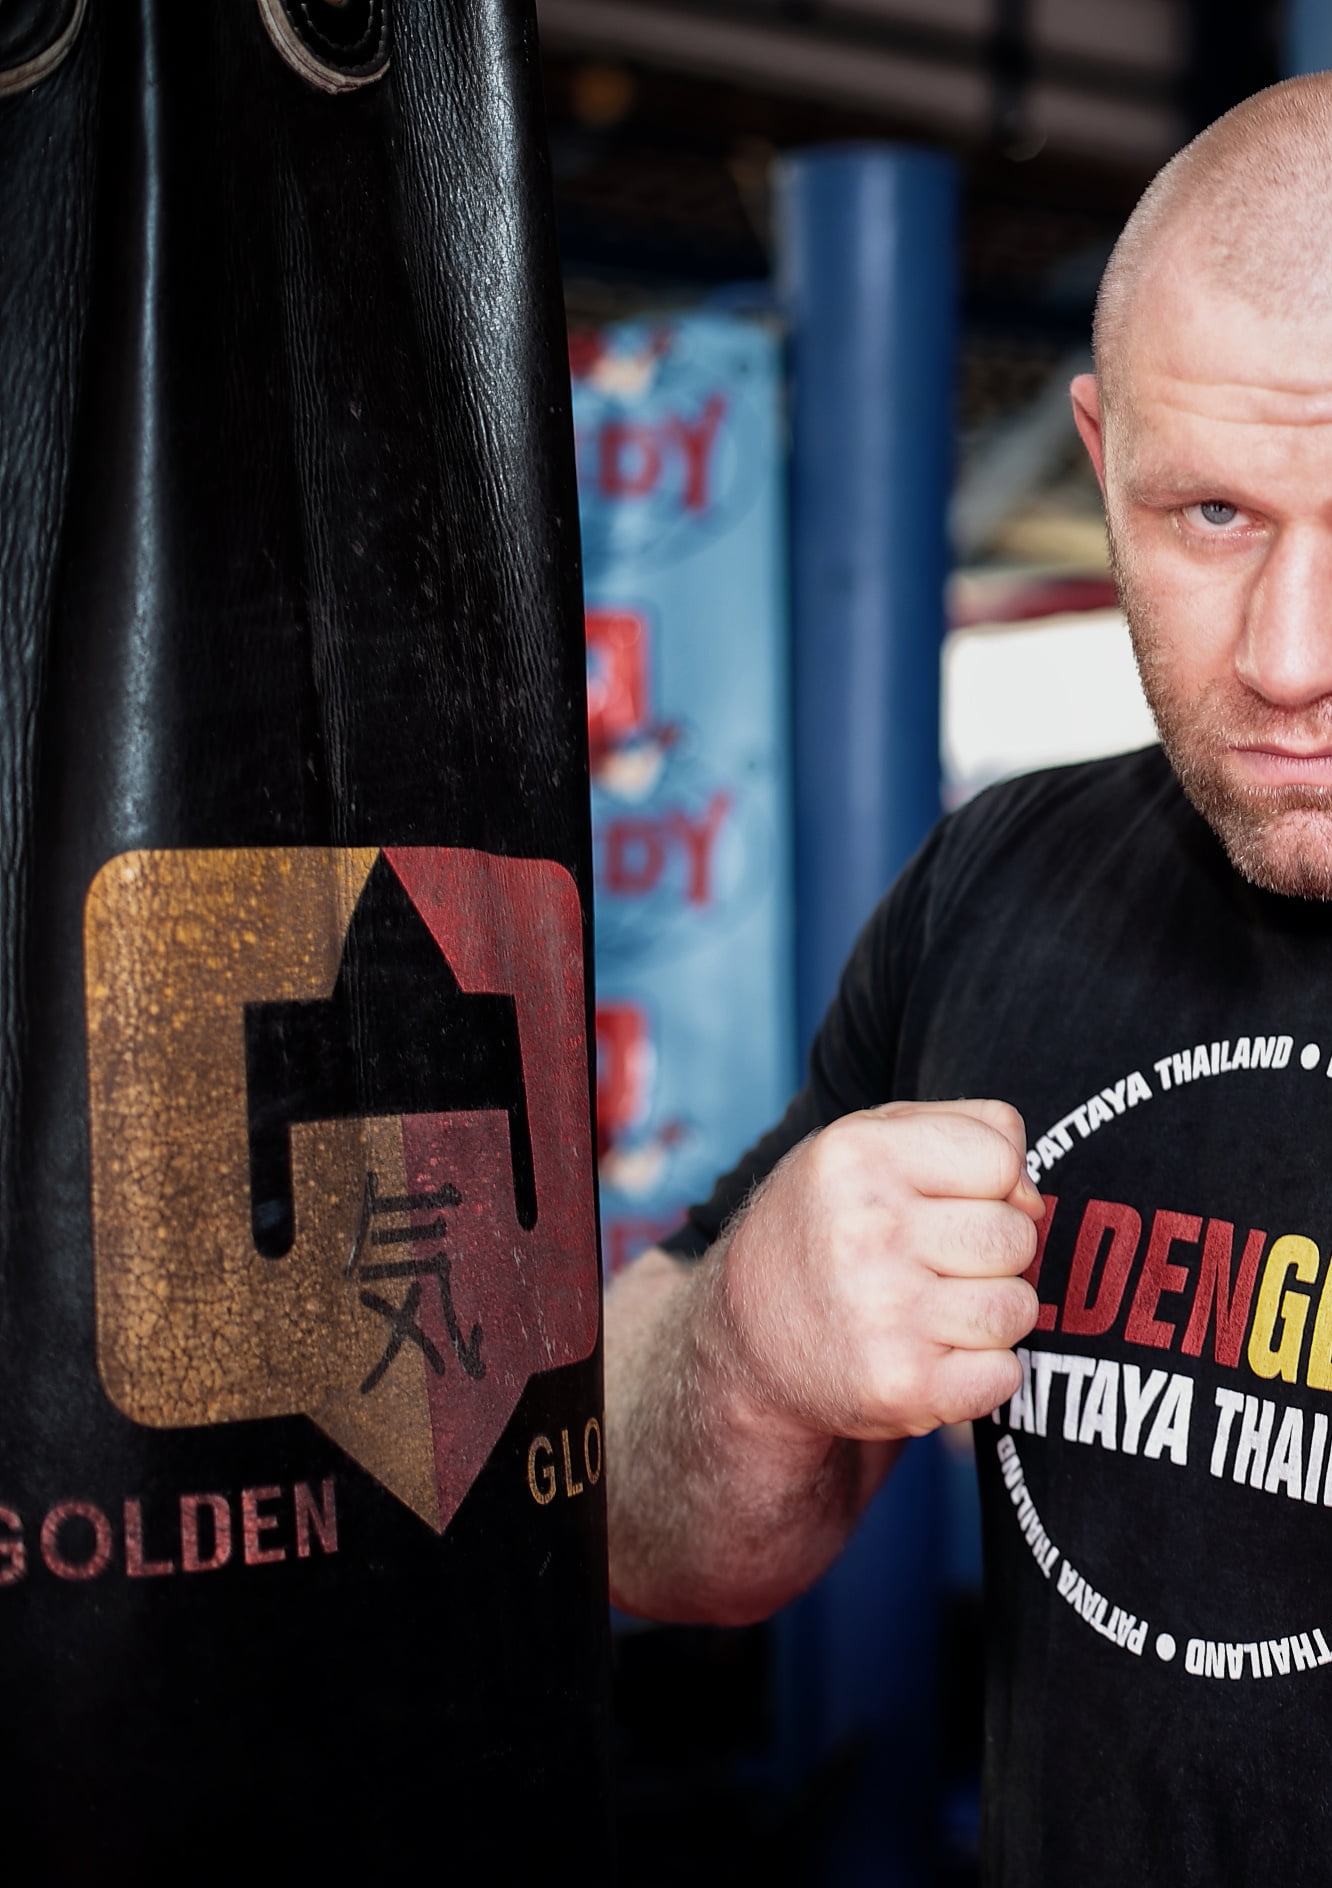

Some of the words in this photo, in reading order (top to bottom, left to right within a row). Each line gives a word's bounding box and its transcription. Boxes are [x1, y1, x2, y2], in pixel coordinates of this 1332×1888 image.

[577, 390, 728, 513] DY
[594, 789, 733, 908] DY
[1026, 1071, 1152, 1184] PATTAYA
[1154, 1035, 1294, 1090] THAILAND
[528, 1417, 601, 1505] GLO
[992, 1347, 1194, 1466] ATTAYA
[997, 1434, 1060, 1579] THAILAND
[1057, 1559, 1149, 1656] PATTAYA
